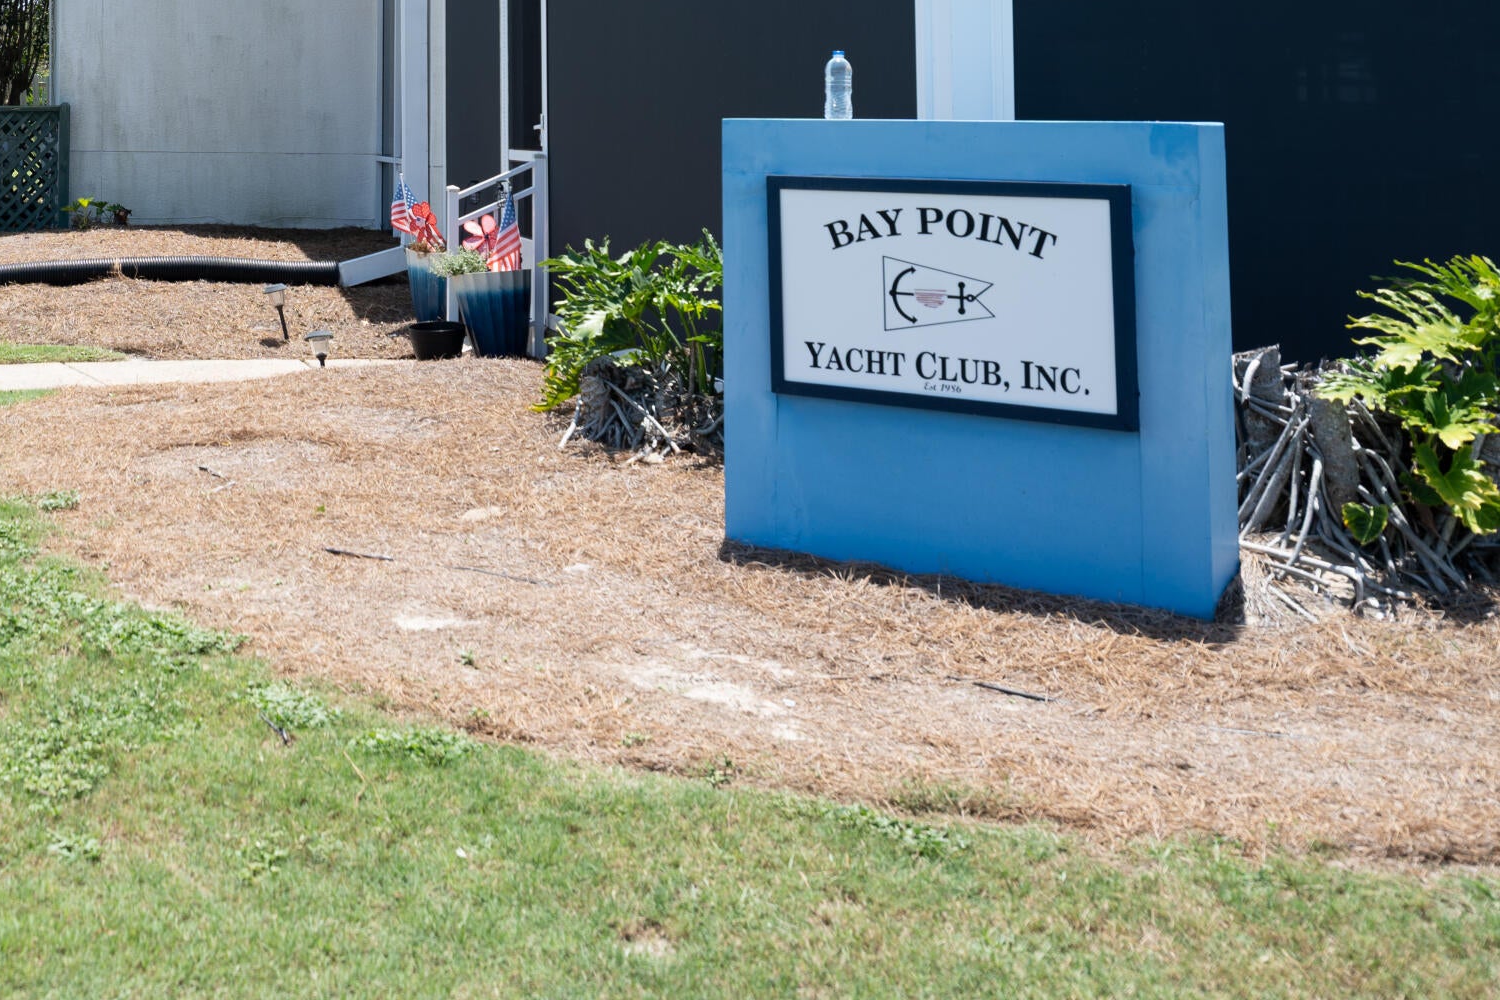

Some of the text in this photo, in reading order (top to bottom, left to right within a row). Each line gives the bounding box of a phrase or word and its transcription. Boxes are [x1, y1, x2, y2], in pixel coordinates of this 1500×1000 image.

[823, 207, 1058, 260] BAY POINT
[804, 341, 1091, 396] YACHT CLUB, INC.
